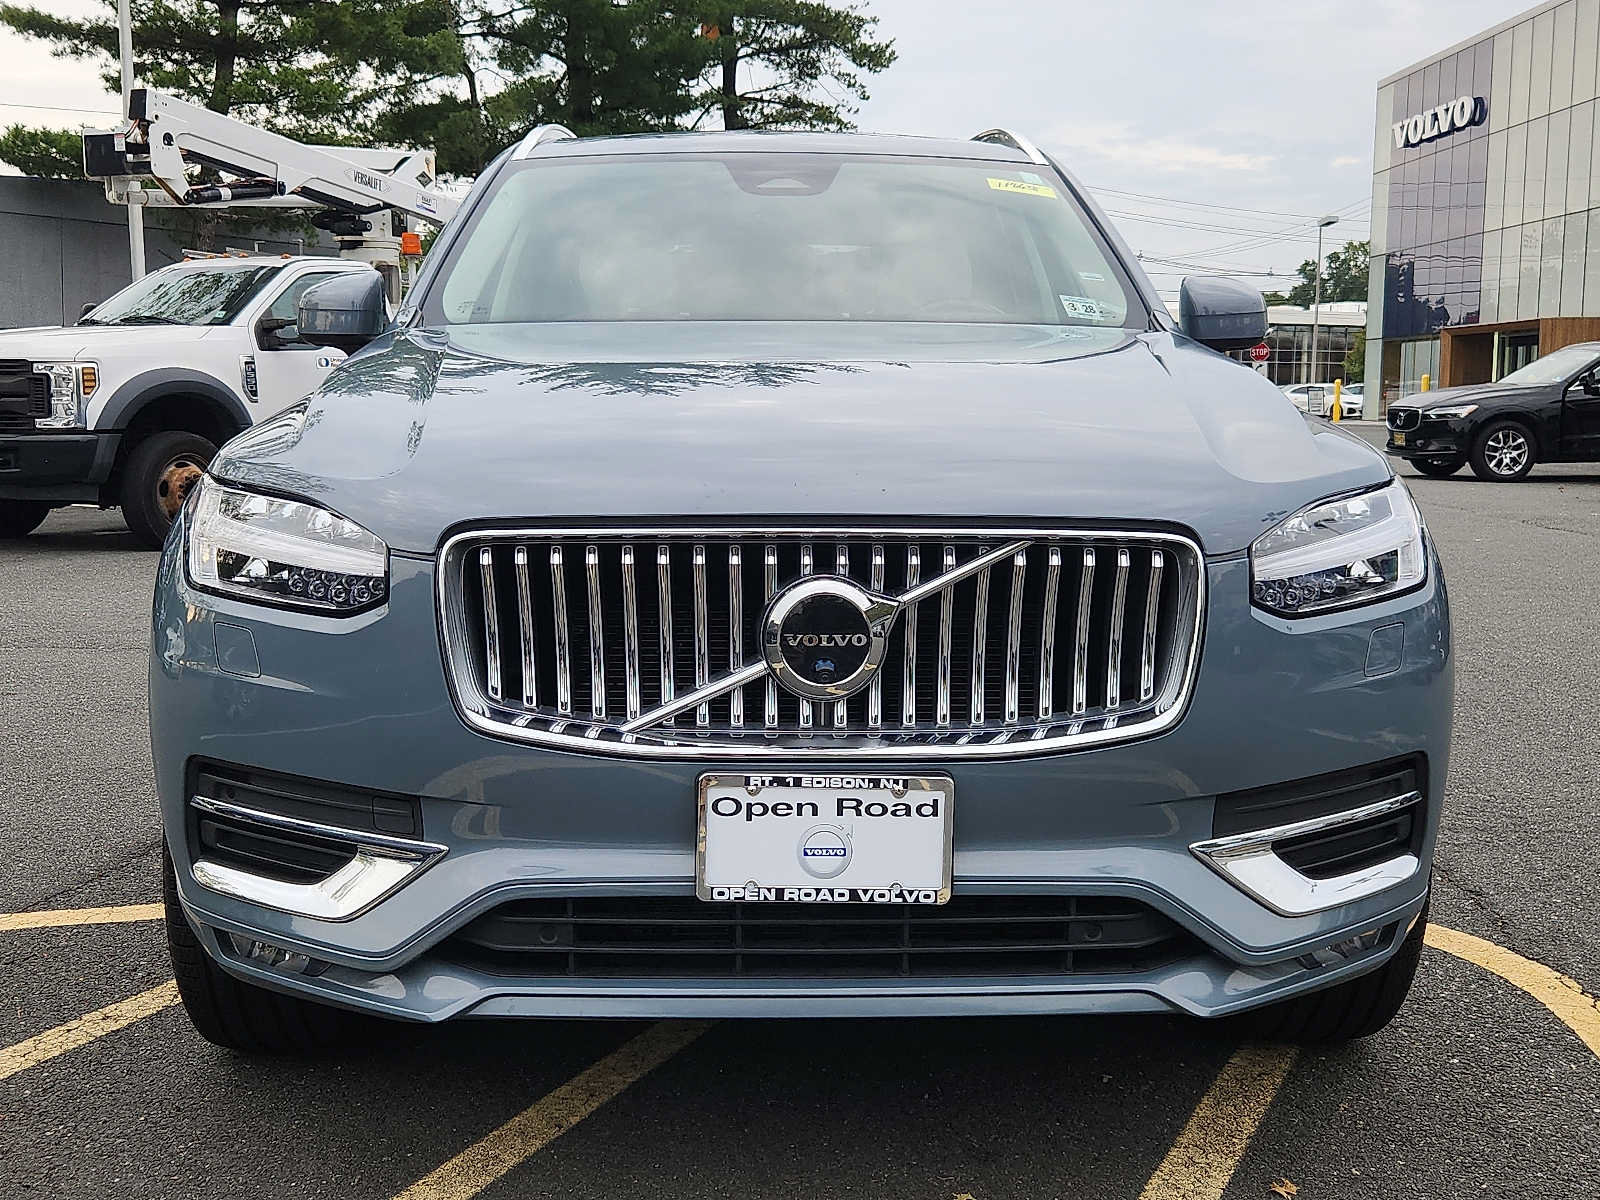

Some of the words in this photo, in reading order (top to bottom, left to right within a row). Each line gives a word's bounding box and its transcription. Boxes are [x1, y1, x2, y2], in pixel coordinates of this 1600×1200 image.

[1392, 96, 1475, 148] VOLVO
[353, 169, 383, 192] VERSALIFT
[1067, 302, 1077, 312] 3
[1081, 304, 1096, 314] 28
[1251, 348, 1268, 357] STOP
[783, 633, 868, 647] VOLVO
[749, 776, 778, 788] RT.
[785, 776, 795, 788] 1
[801, 777, 874, 789] EDISON,
[880, 778, 904, 790] NJ
[711, 796, 819, 822] Open
[836, 797, 939, 818] Road
[805, 848, 846, 857] VOLVO
[712, 887, 776, 901] OPEN
[783, 888, 850, 902] ROAD
[858, 888, 936, 903] VOLVO
